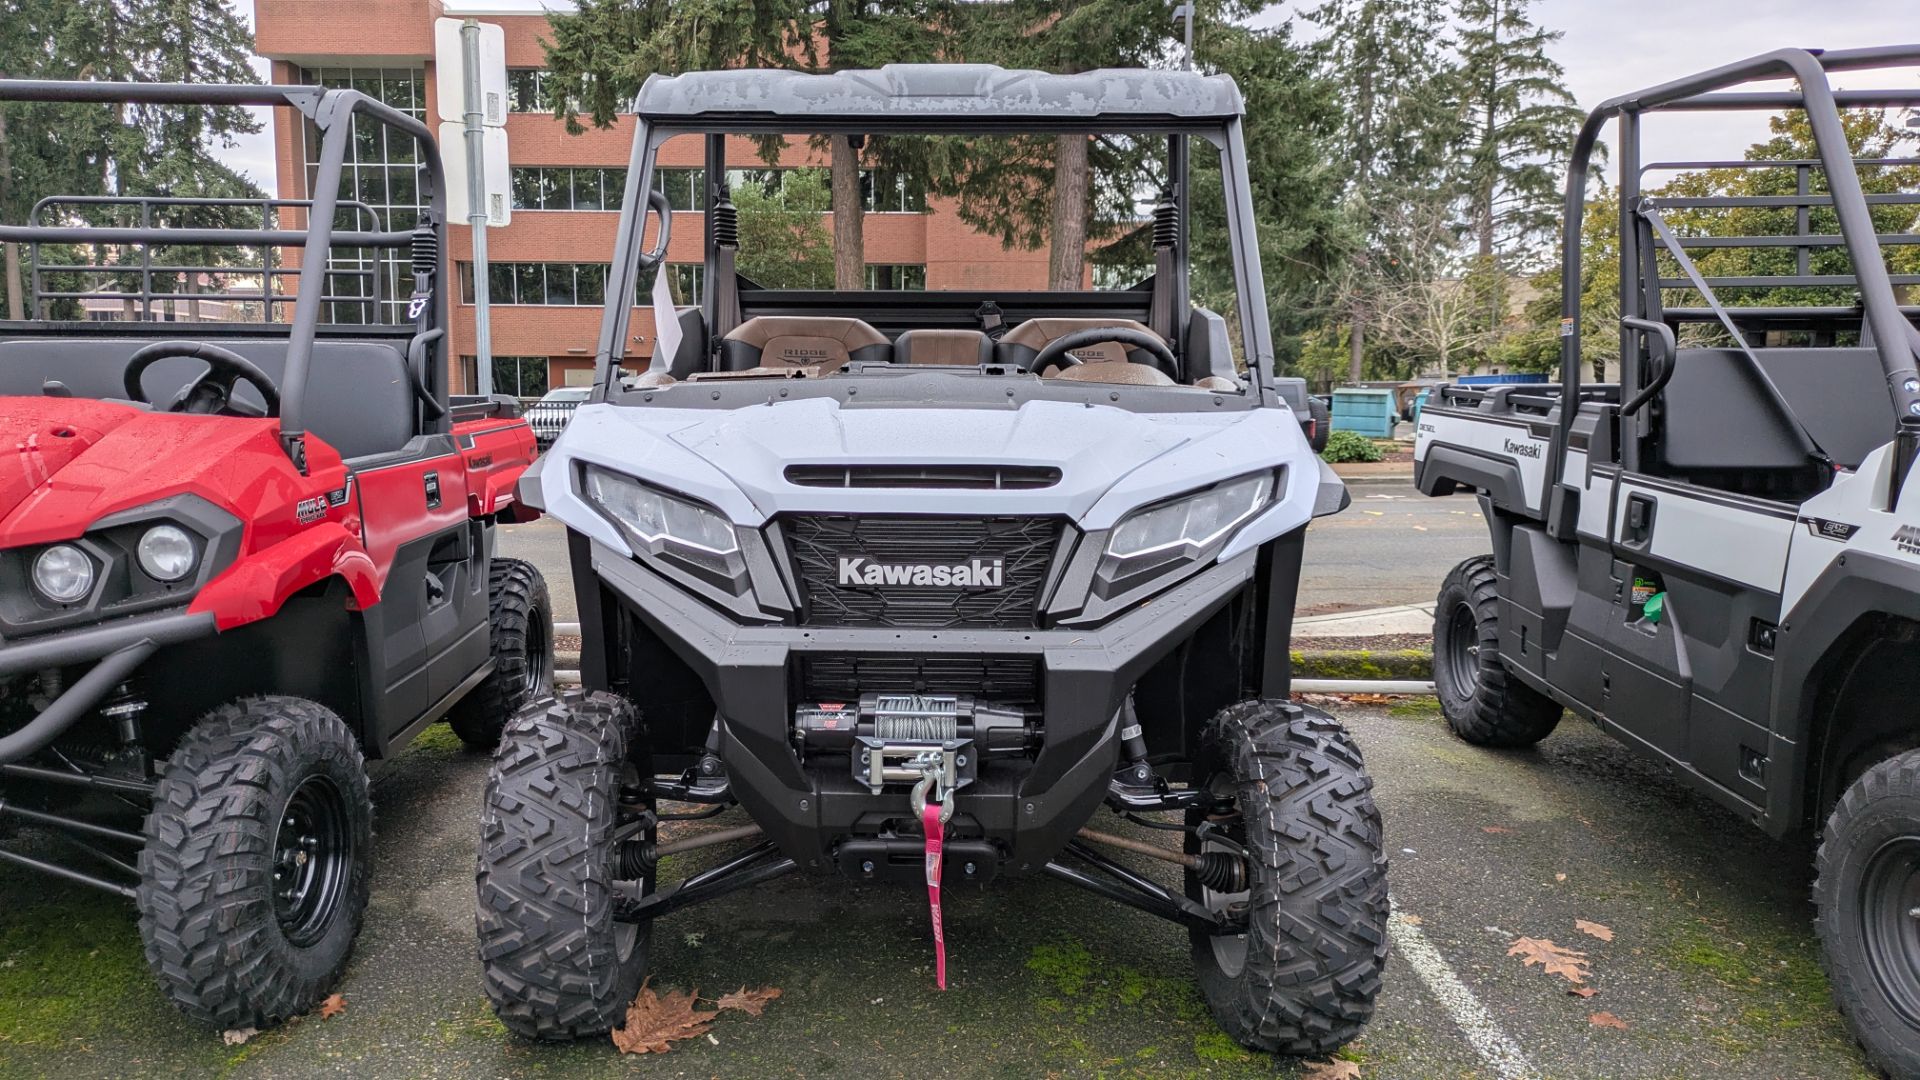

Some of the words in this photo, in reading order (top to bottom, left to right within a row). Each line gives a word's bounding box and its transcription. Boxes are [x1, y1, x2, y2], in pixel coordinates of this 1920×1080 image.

[1503, 439, 1542, 459] Kawasaki
[297, 496, 328, 518] MULE
[839, 557, 1003, 587] Kawasaki
[930, 904, 943, 943] WARN
